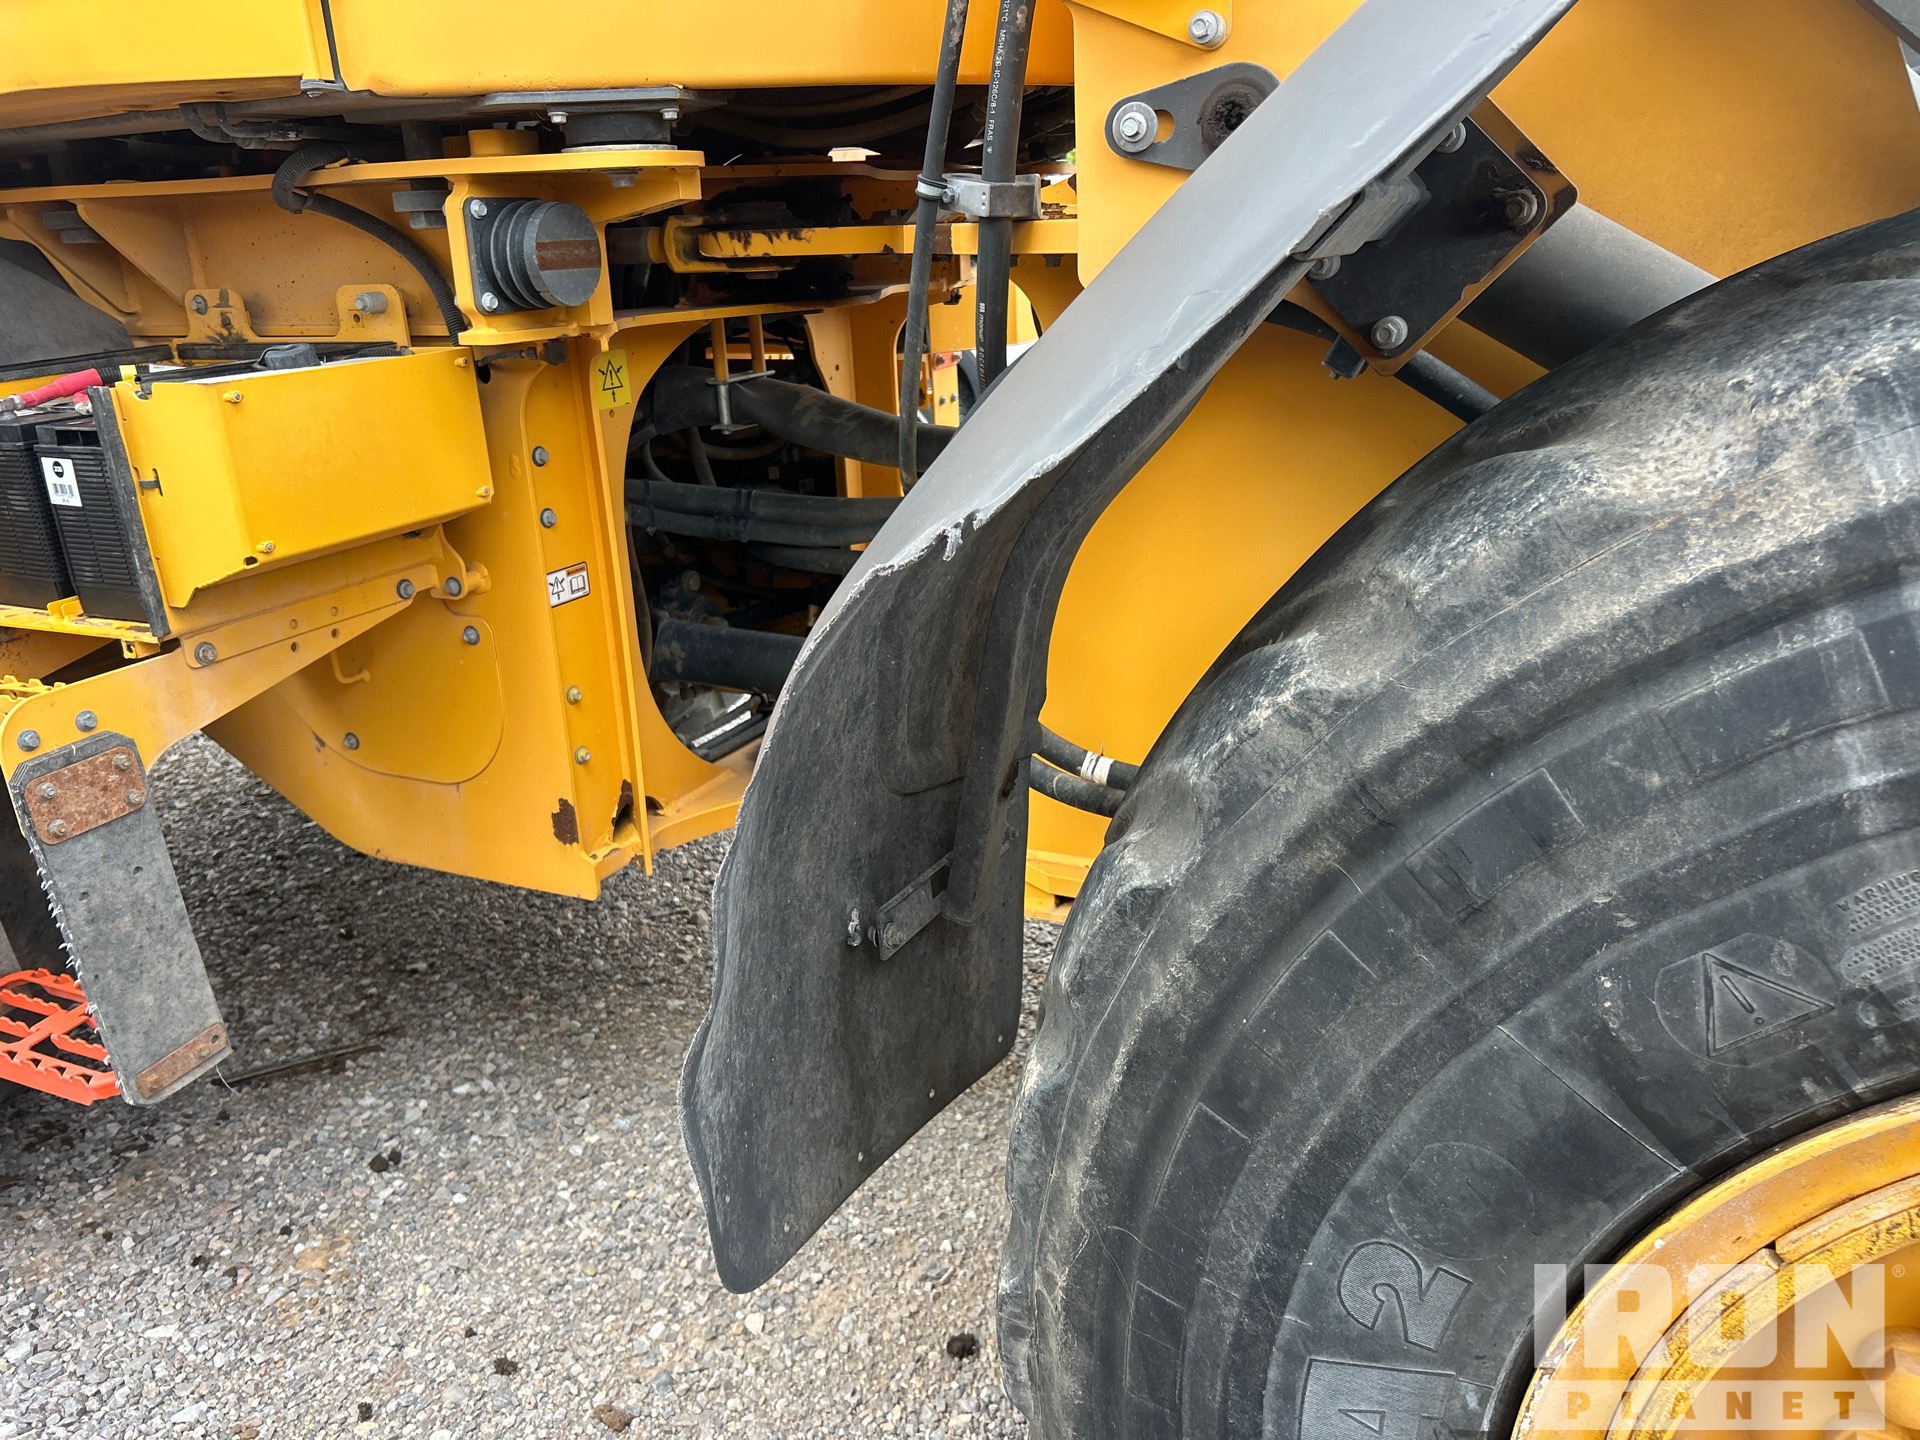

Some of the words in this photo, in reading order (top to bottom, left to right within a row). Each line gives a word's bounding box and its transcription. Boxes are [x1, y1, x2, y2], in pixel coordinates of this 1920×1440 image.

[997, 29, 1006, 55] MSHA
[986, 119, 995, 141] FRAS
[1836, 870, 1920, 912] WARNING
